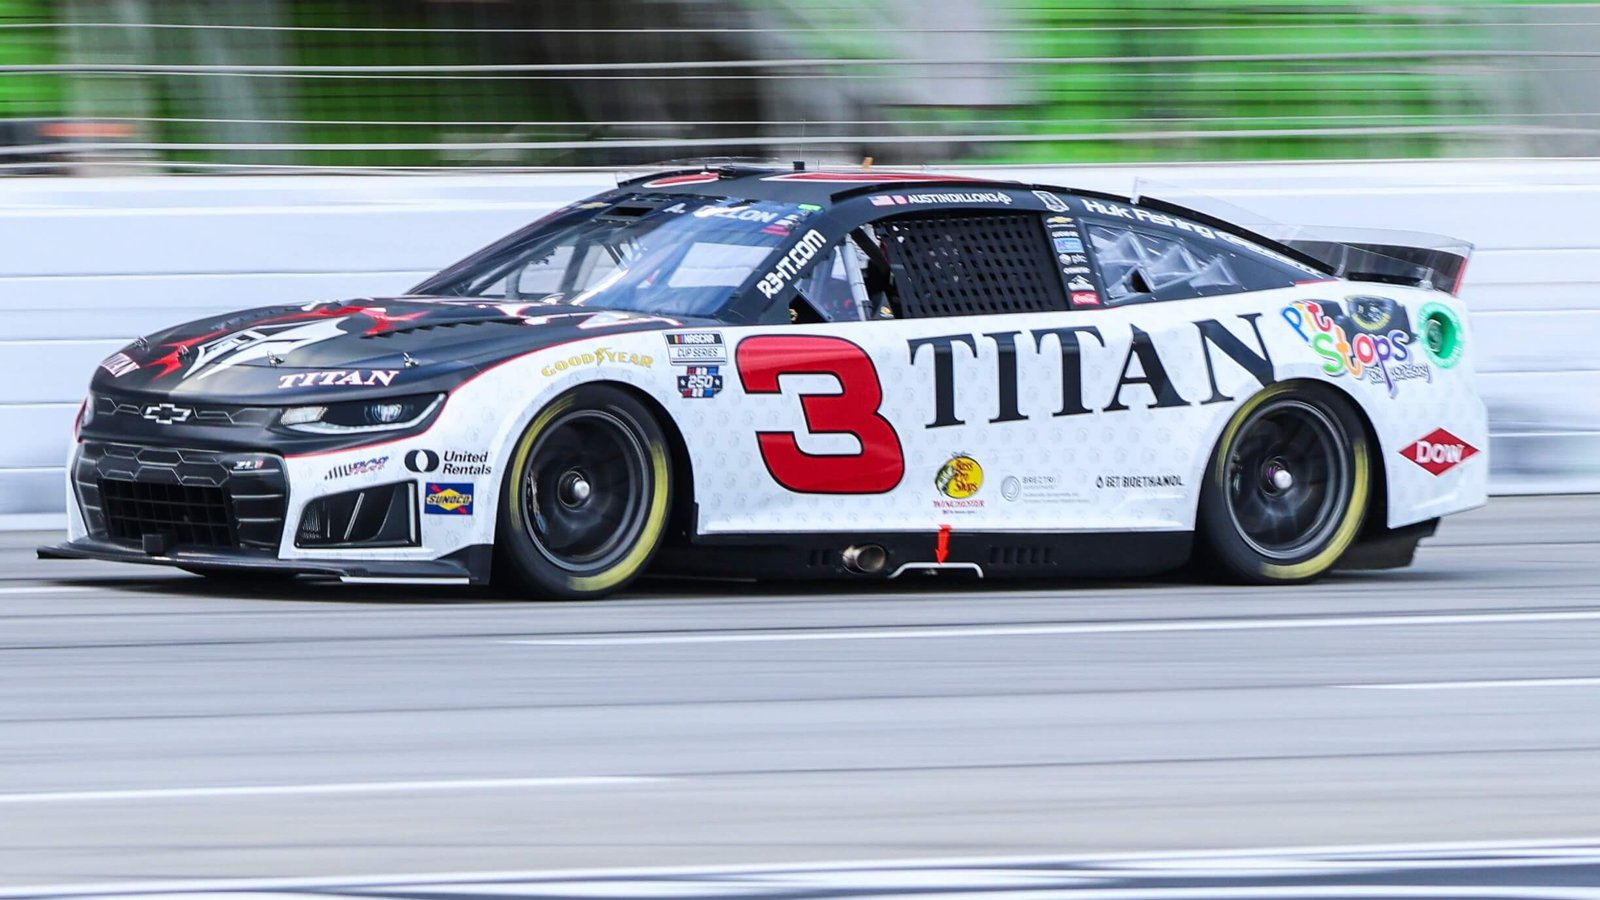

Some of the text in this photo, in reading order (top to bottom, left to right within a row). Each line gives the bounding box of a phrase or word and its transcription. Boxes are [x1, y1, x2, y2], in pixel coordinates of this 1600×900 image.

[1080, 199, 1217, 240] Huk Fishing
[756, 229, 827, 299] R3-IT.COM
[1281, 301, 1332, 342] Pit
[684, 334, 715, 344] NASCAR
[677, 348, 718, 357] CUP SERIES
[1312, 326, 1408, 395] Stops
[541, 347, 654, 377] GOODYEAR
[907, 313, 1276, 428] TITAN
[278, 370, 399, 388] TITAN
[687, 375, 714, 388] 250
[735, 334, 905, 494] 3
[444, 450, 488, 464] United
[442, 463, 491, 476] Rentals
[1106, 475, 1184, 489] GET BIOETHANOL
[427, 494, 471, 505] SUNOCO
